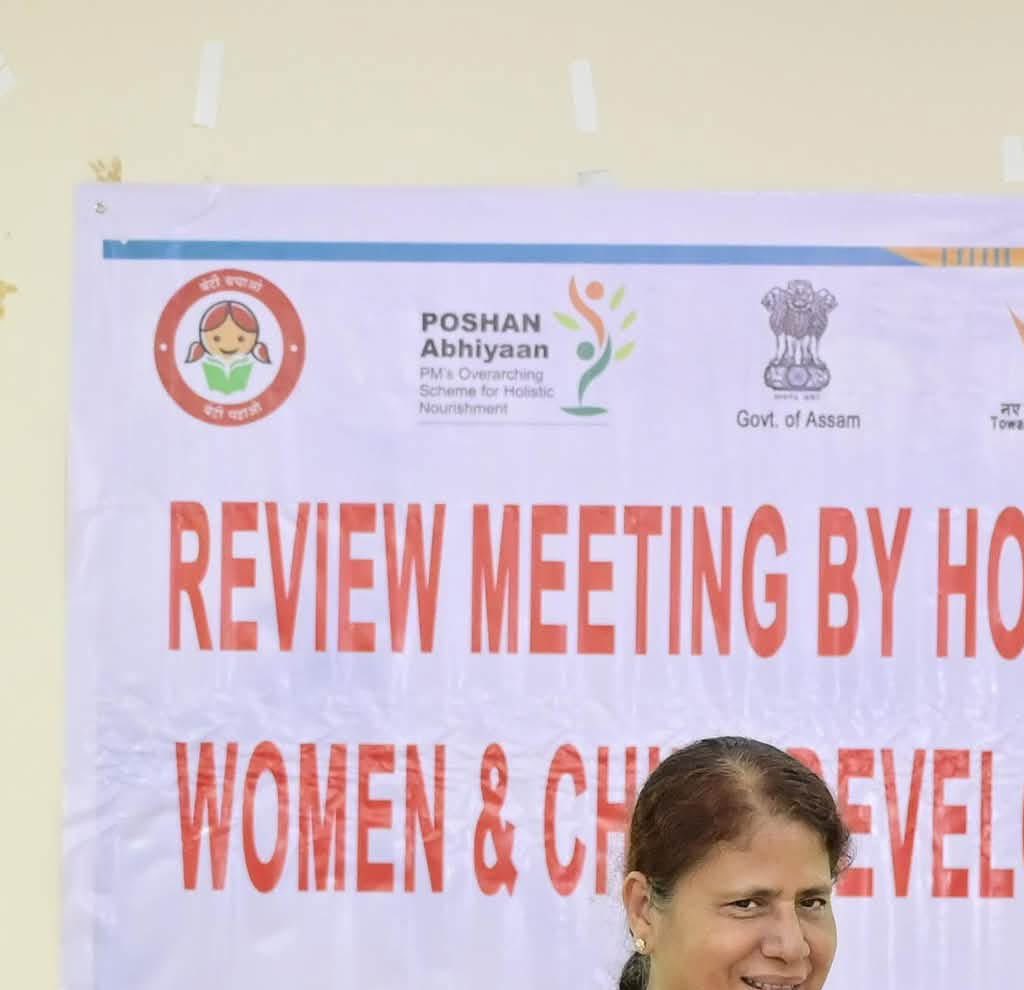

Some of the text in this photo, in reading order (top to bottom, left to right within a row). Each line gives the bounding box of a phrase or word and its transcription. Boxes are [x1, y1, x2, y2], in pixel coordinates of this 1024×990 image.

[421, 312, 541, 333] POSHAN
[420, 338, 549, 363] Abhiyaan
[459, 367, 544, 384] Overarching
[419, 384, 555, 399] Scheme for Holistic
[419, 401, 508, 415] Nourishment
[736, 409, 861, 428] Govt. of Assam
[169, 501, 446, 652] REVIEW
[470, 503, 788, 659] MEETING
[817, 506, 912, 657] BY
[176, 740, 445, 893] WOMEN
[473, 742, 519, 897] &
